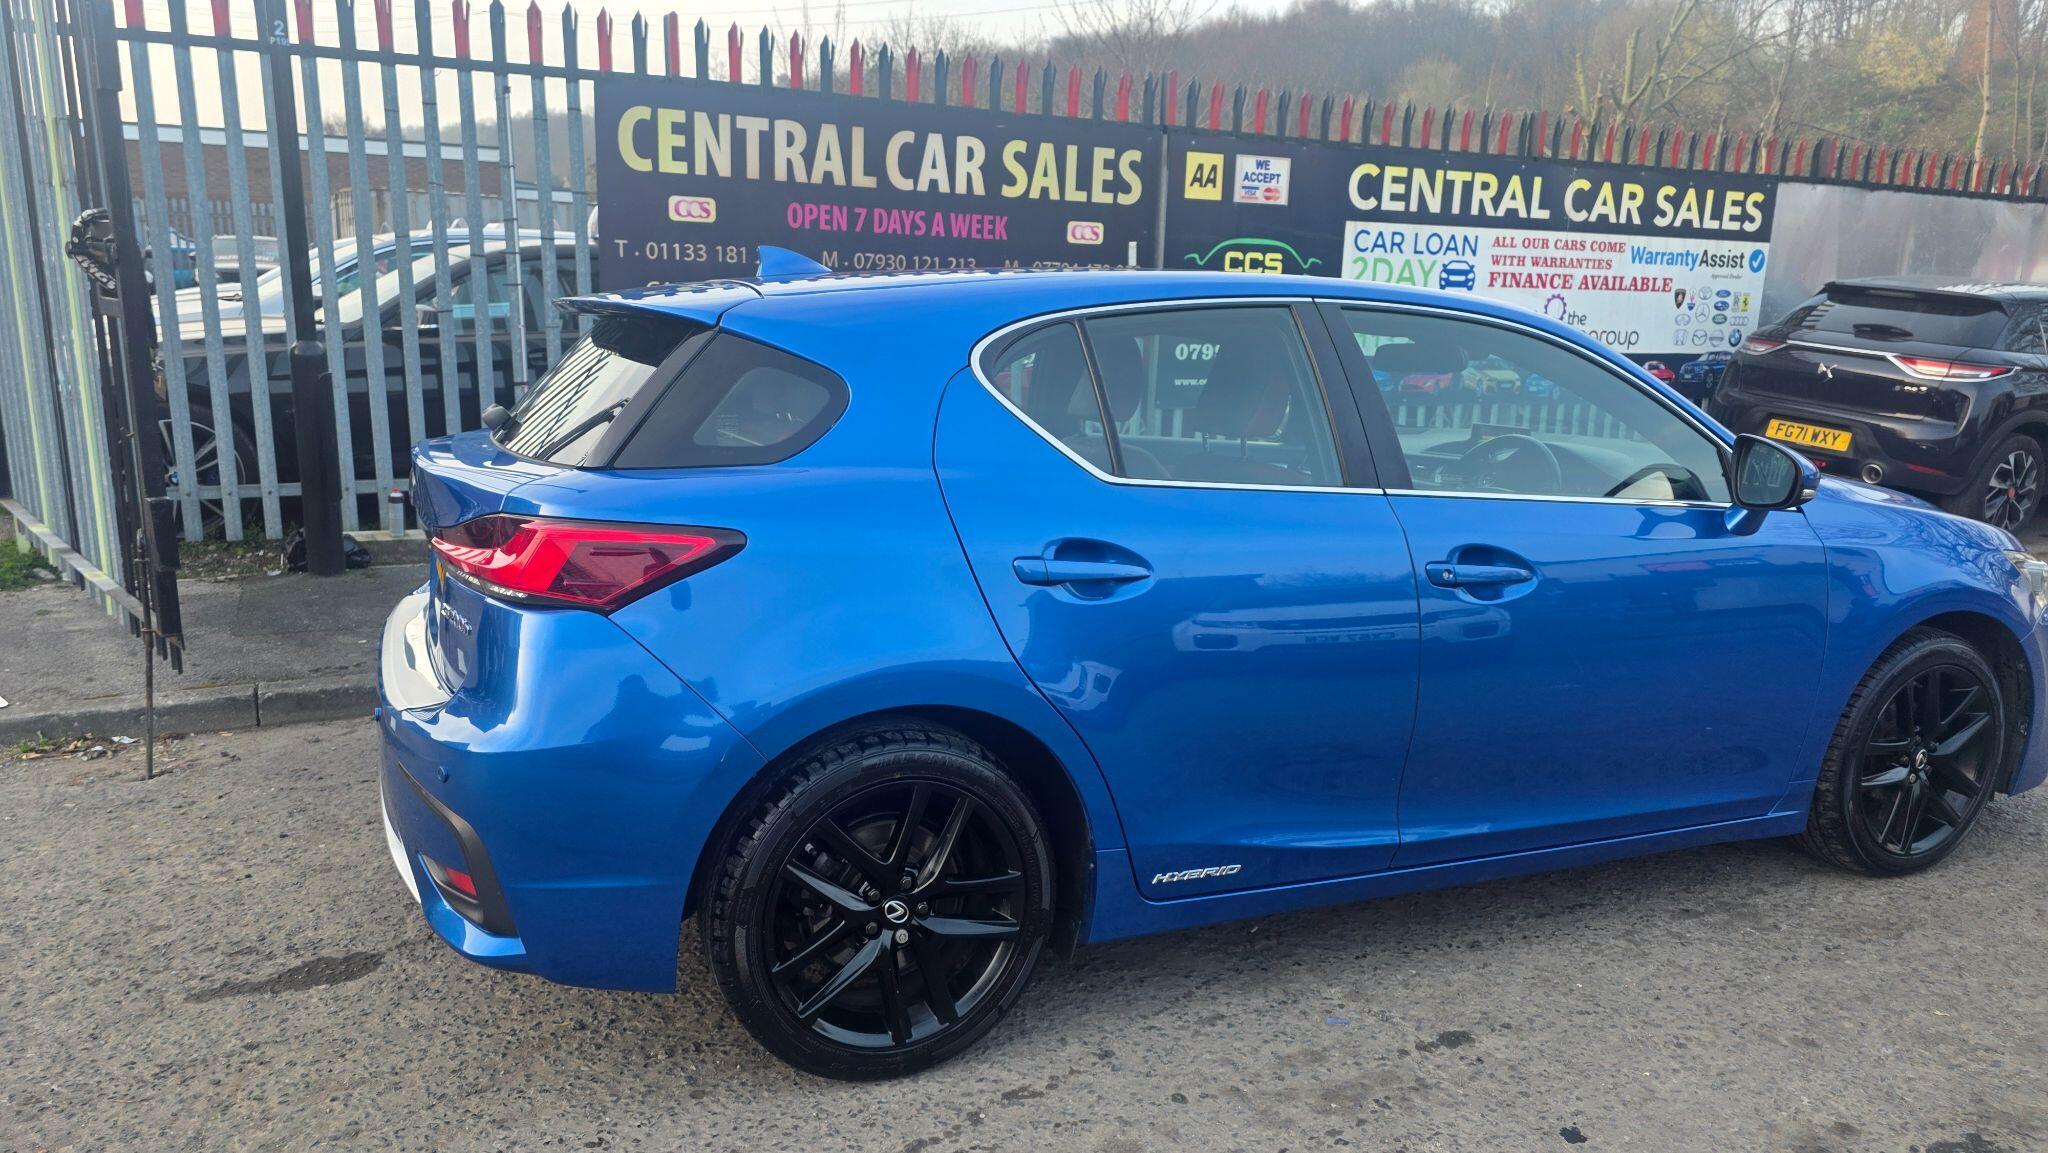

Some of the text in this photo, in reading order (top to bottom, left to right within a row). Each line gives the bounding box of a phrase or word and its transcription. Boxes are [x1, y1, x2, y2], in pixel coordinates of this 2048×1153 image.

[273, 19, 285, 36] 2
[617, 105, 1143, 205] CENTRAL CAR SALES
[1255, 159, 1271, 170] WE
[1189, 163, 1218, 188] AA
[1243, 171, 1282, 184] ACCEPT
[1348, 163, 1766, 232] CENTRAL CAR SALES
[787, 202, 1008, 240] OPEN 7 DAYS A WEEK
[646, 241, 707, 262] 01133
[716, 245, 747, 264] 181
[1354, 229, 1479, 257] CAR LOAN
[1492, 236, 1627, 254] ALL OUR CARS COME
[853, 252, 907, 271] 07930
[913, 255, 940, 270] 121
[948, 257, 977, 269] 213
[1224, 251, 1283, 274] CCS
[1352, 256, 1438, 288] 2DAY
[1491, 254, 1613, 270] WITH WARRANTIES
[1488, 272, 1674, 293] FINANCE AVAILABLE
[1567, 311, 1587, 326] the
[1775, 422, 1841, 446] FG71 WXY
[1151, 864, 1242, 885] HYBRID
